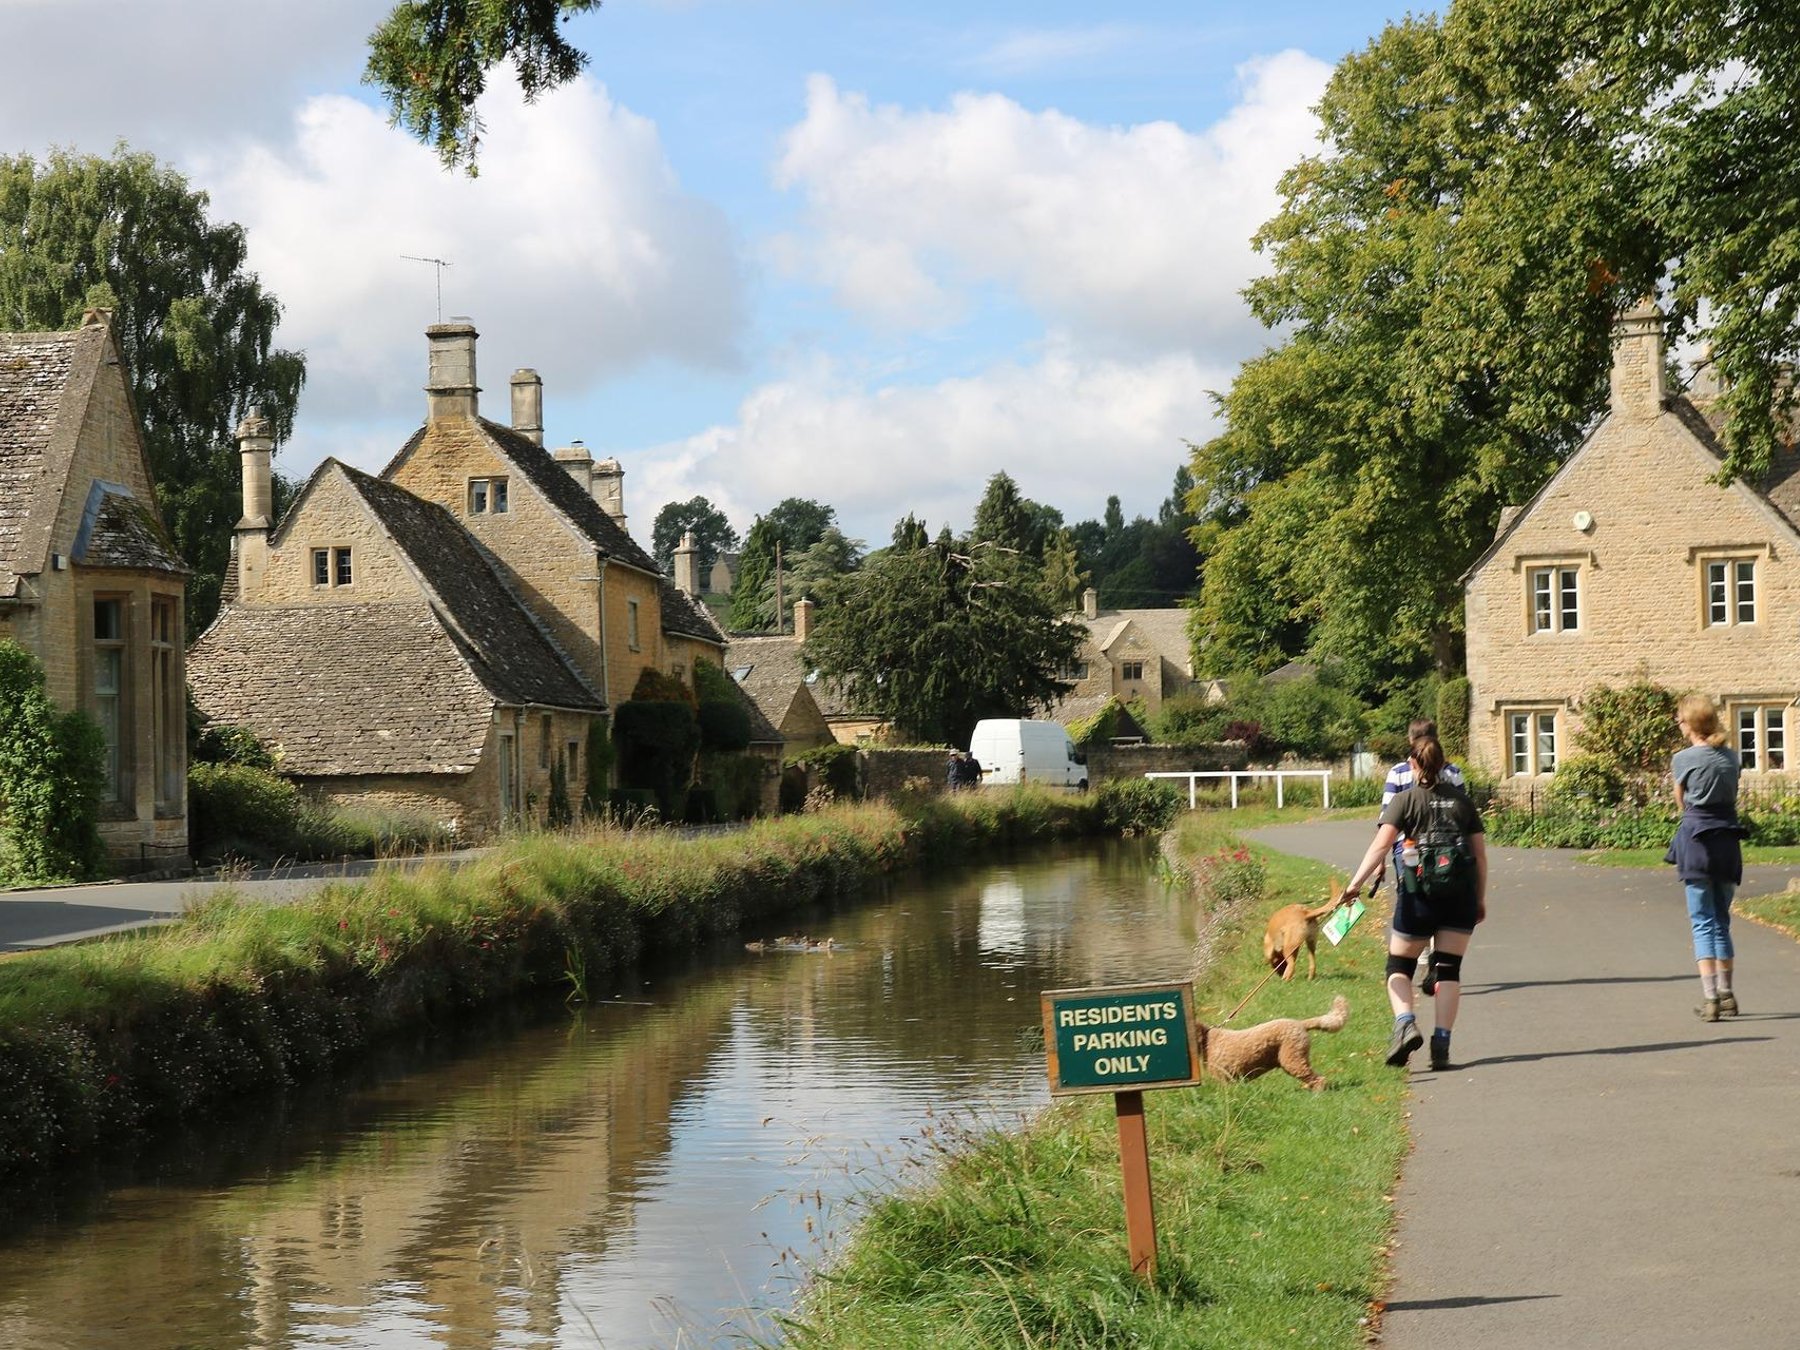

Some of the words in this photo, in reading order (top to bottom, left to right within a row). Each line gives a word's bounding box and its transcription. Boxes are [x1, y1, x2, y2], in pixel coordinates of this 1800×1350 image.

[1060, 1002, 1177, 1027] RESIDENTS
[1073, 1028, 1167, 1051] PARKING
[1094, 1055, 1150, 1075] ONLY
